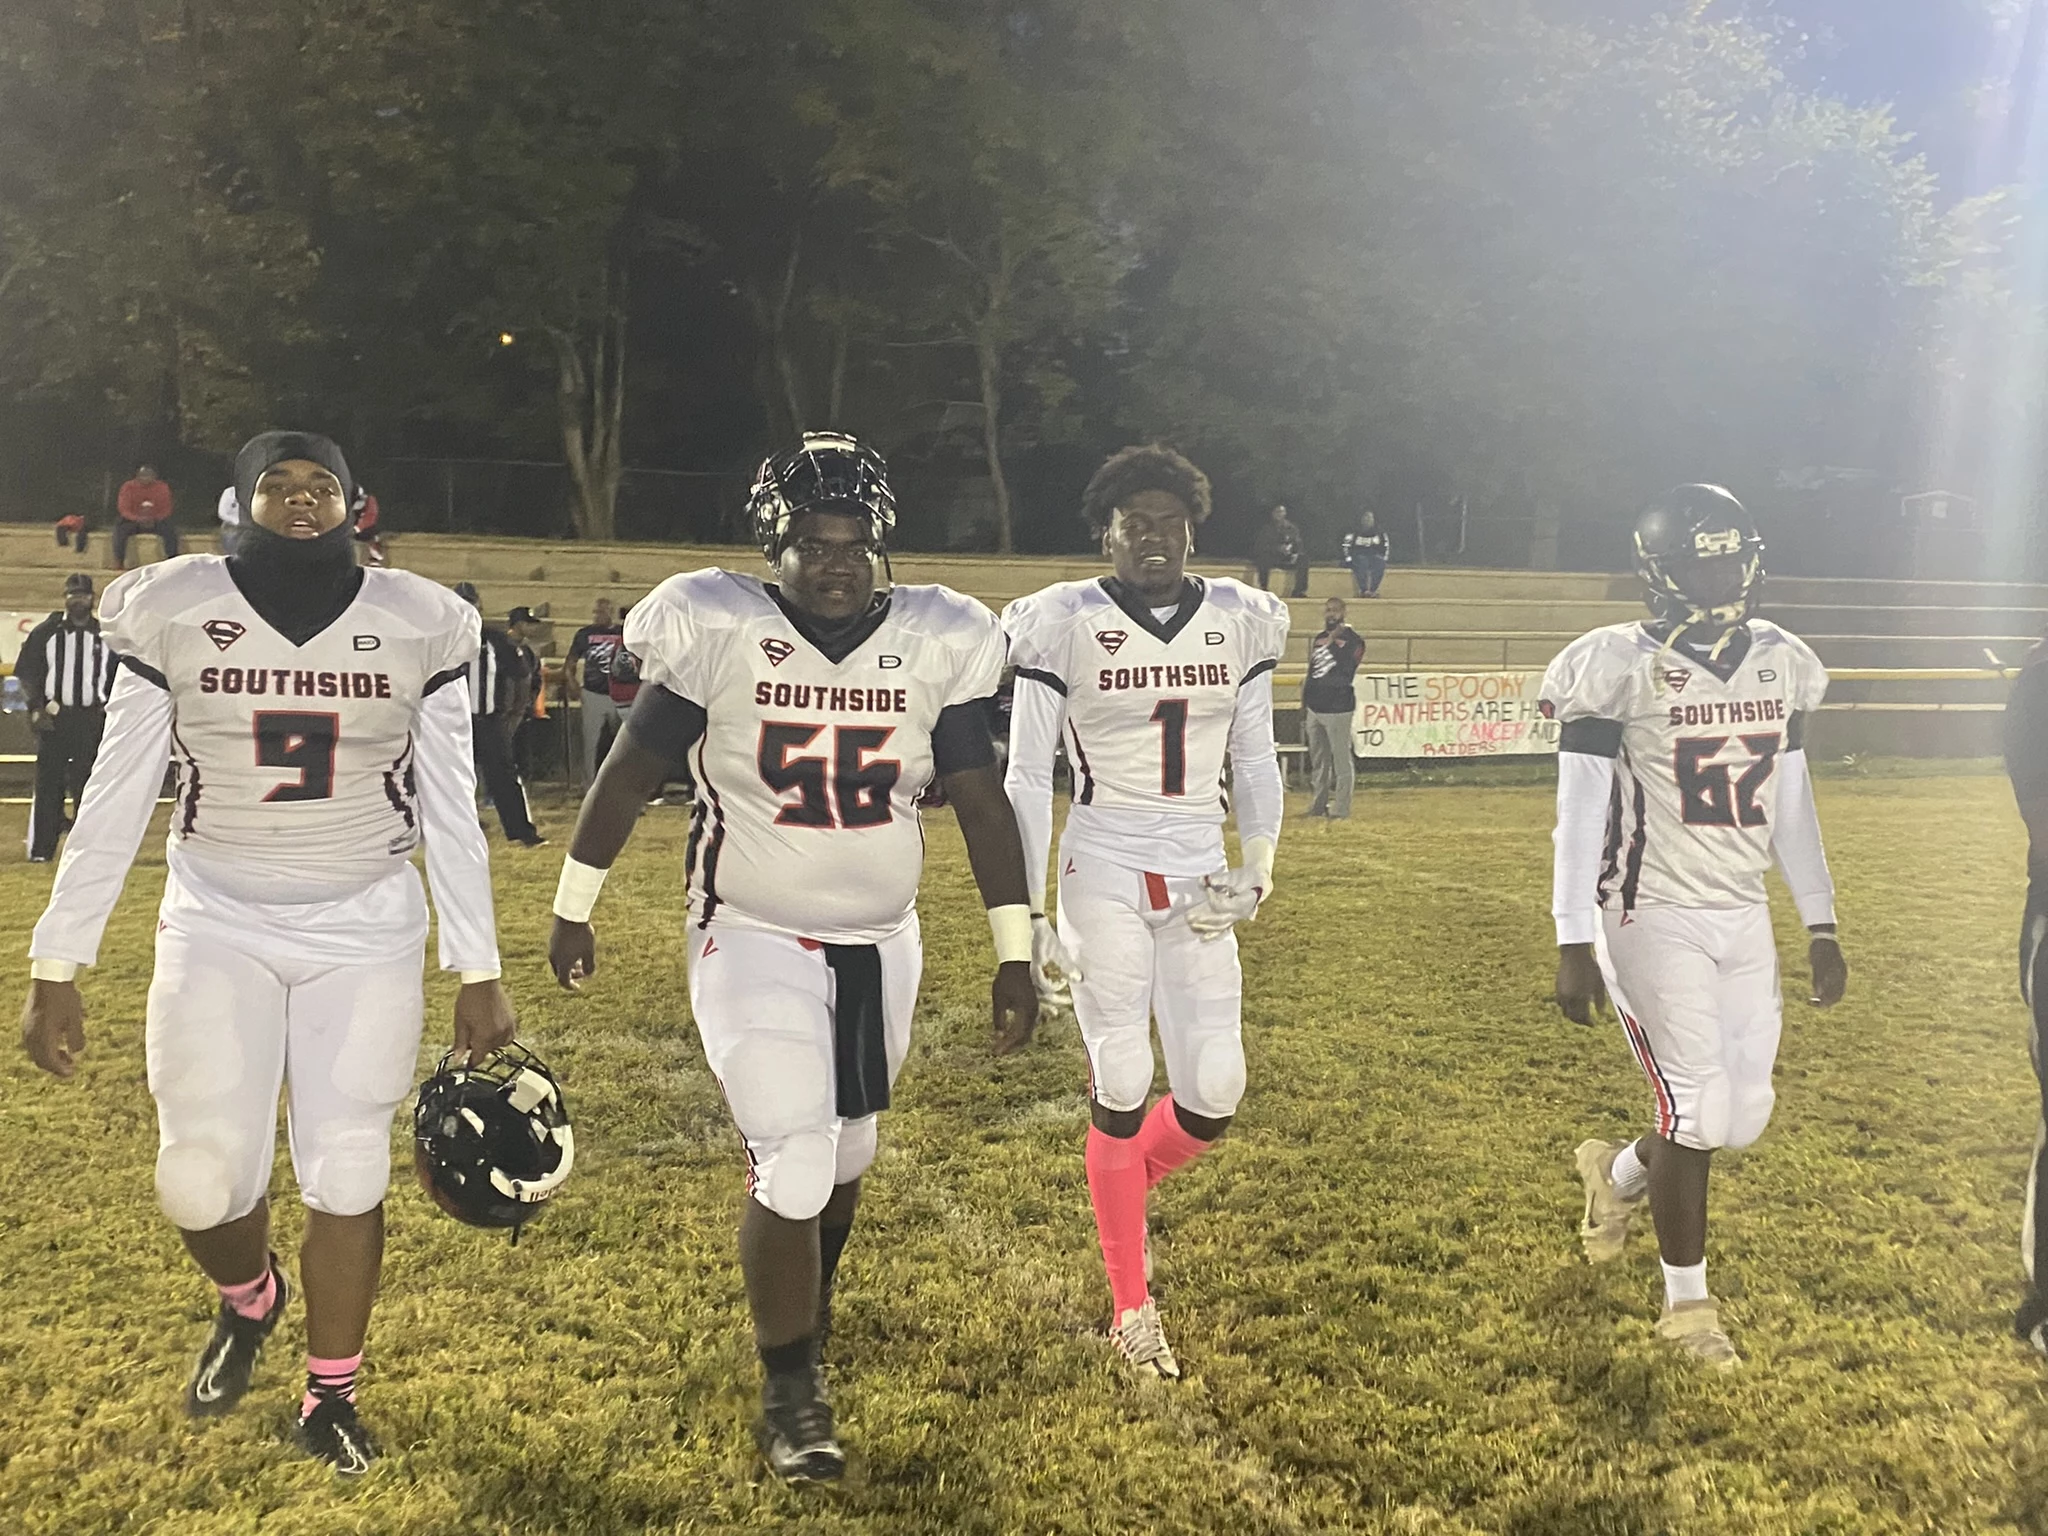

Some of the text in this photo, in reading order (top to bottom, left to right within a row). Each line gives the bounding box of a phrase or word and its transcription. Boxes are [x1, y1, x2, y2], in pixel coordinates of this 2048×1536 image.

[200, 666, 391, 699] SOUTHSIDE
[1098, 663, 1230, 691] SOUTHSIDE
[1366, 673, 1525, 700] THE SPOOKY
[755, 680, 907, 713] SOUTHSIDE
[1364, 699, 1544, 727] PANTHERS ARE HE
[1669, 699, 1785, 727] SOUTHSIDE
[1149, 698, 1189, 797] 1
[1357, 729, 1384, 746] TO
[1422, 741, 1497, 756] RAIDERS
[253, 710, 339, 803] 9
[757, 719, 902, 830] 56
